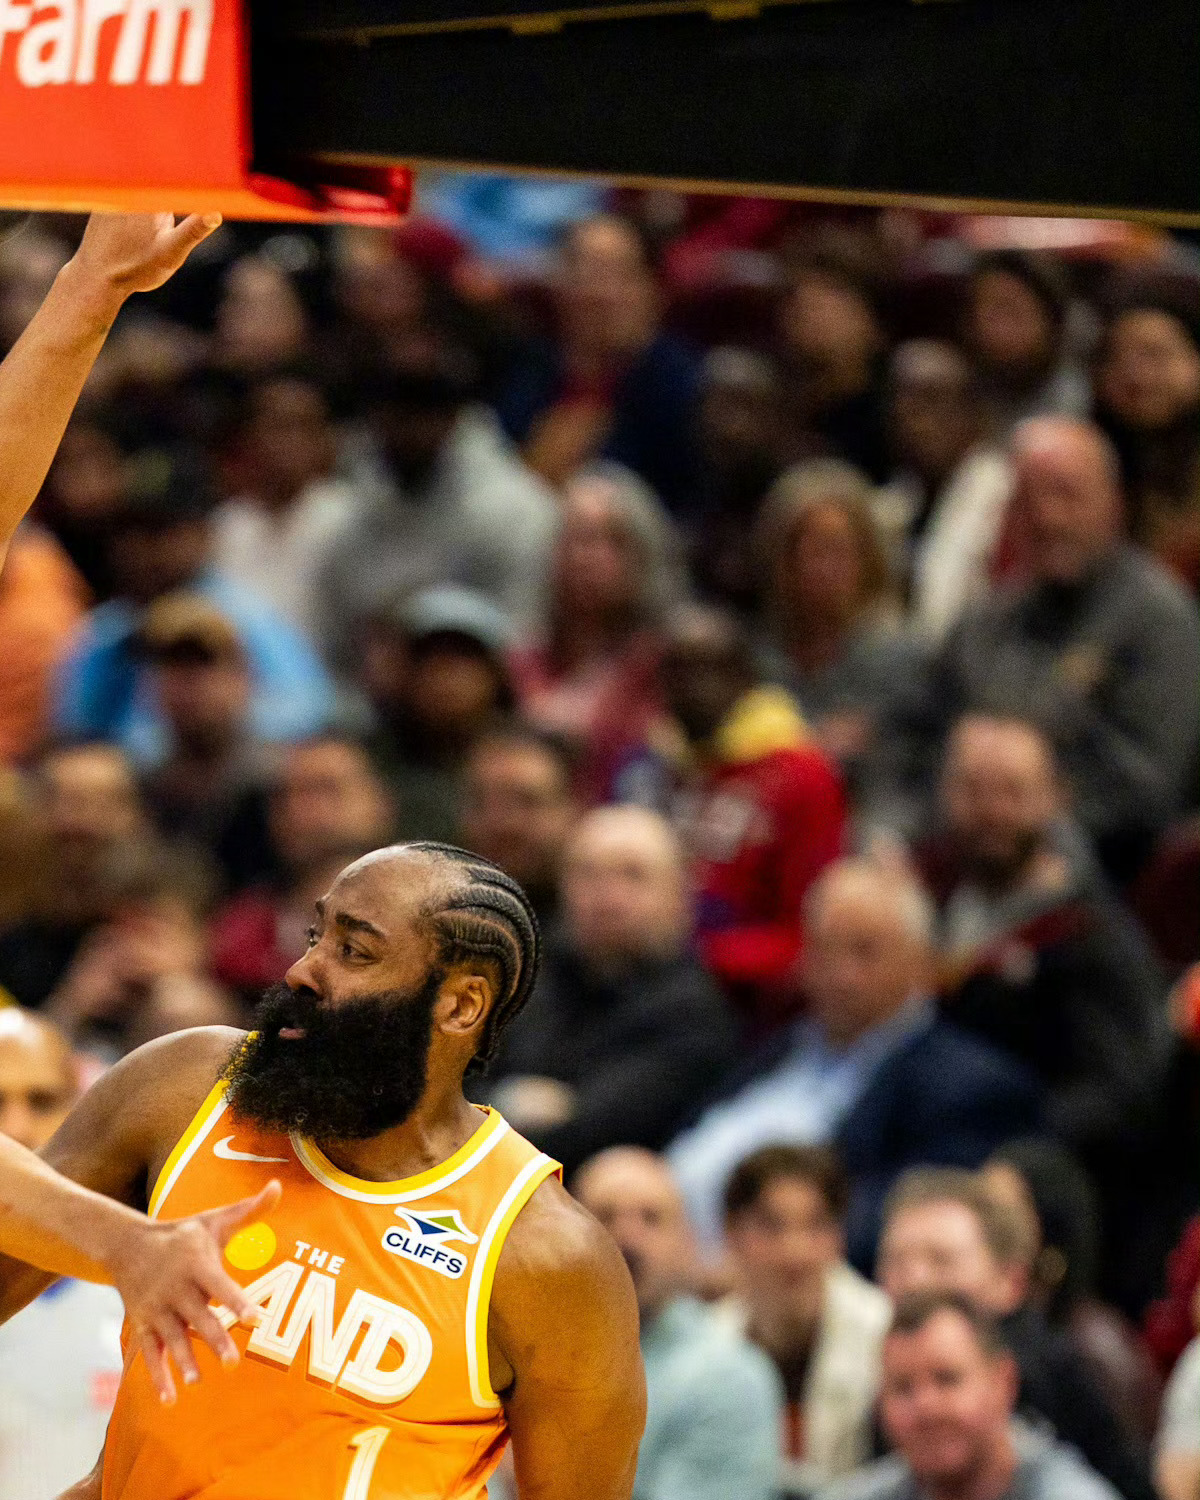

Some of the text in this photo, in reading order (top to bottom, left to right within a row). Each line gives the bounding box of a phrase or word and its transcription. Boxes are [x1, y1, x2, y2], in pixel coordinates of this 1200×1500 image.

[294, 1240, 346, 1275] THE
[385, 1231, 464, 1276] CLIFFS
[210, 1259, 434, 1410] AND
